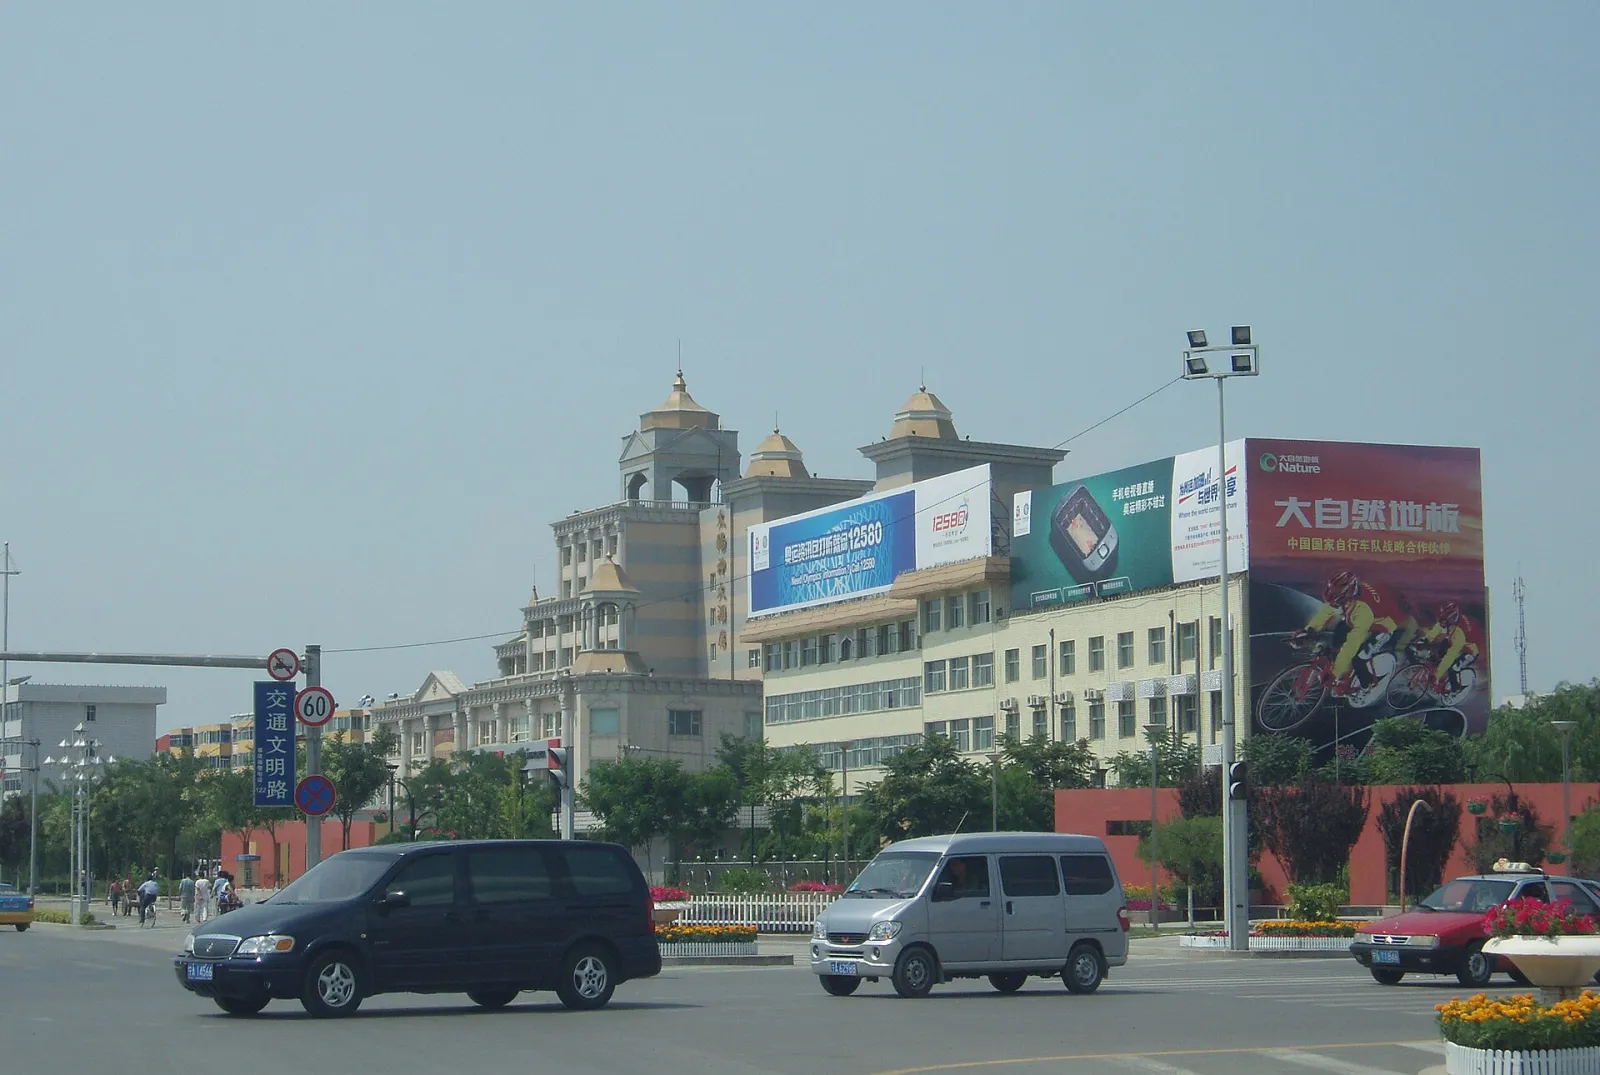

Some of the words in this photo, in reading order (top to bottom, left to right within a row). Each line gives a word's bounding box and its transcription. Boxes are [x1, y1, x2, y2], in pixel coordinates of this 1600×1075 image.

[1279, 463, 1320, 473] Nature
[1112, 480, 1154, 501] 手机电视看直播
[1197, 476, 1237, 505] 与世界享
[1123, 494, 1165, 515] 奥运精彩不错过
[1274, 497, 1460, 533] 大自然地板
[932, 510, 966, 532] 12580
[1288, 537, 1450, 555] 中国国家自行车队战略合作伙伴
[304, 696, 326, 717] 60
[266, 689, 288, 800] 交通文明路
[256, 786, 267, 794] 122
